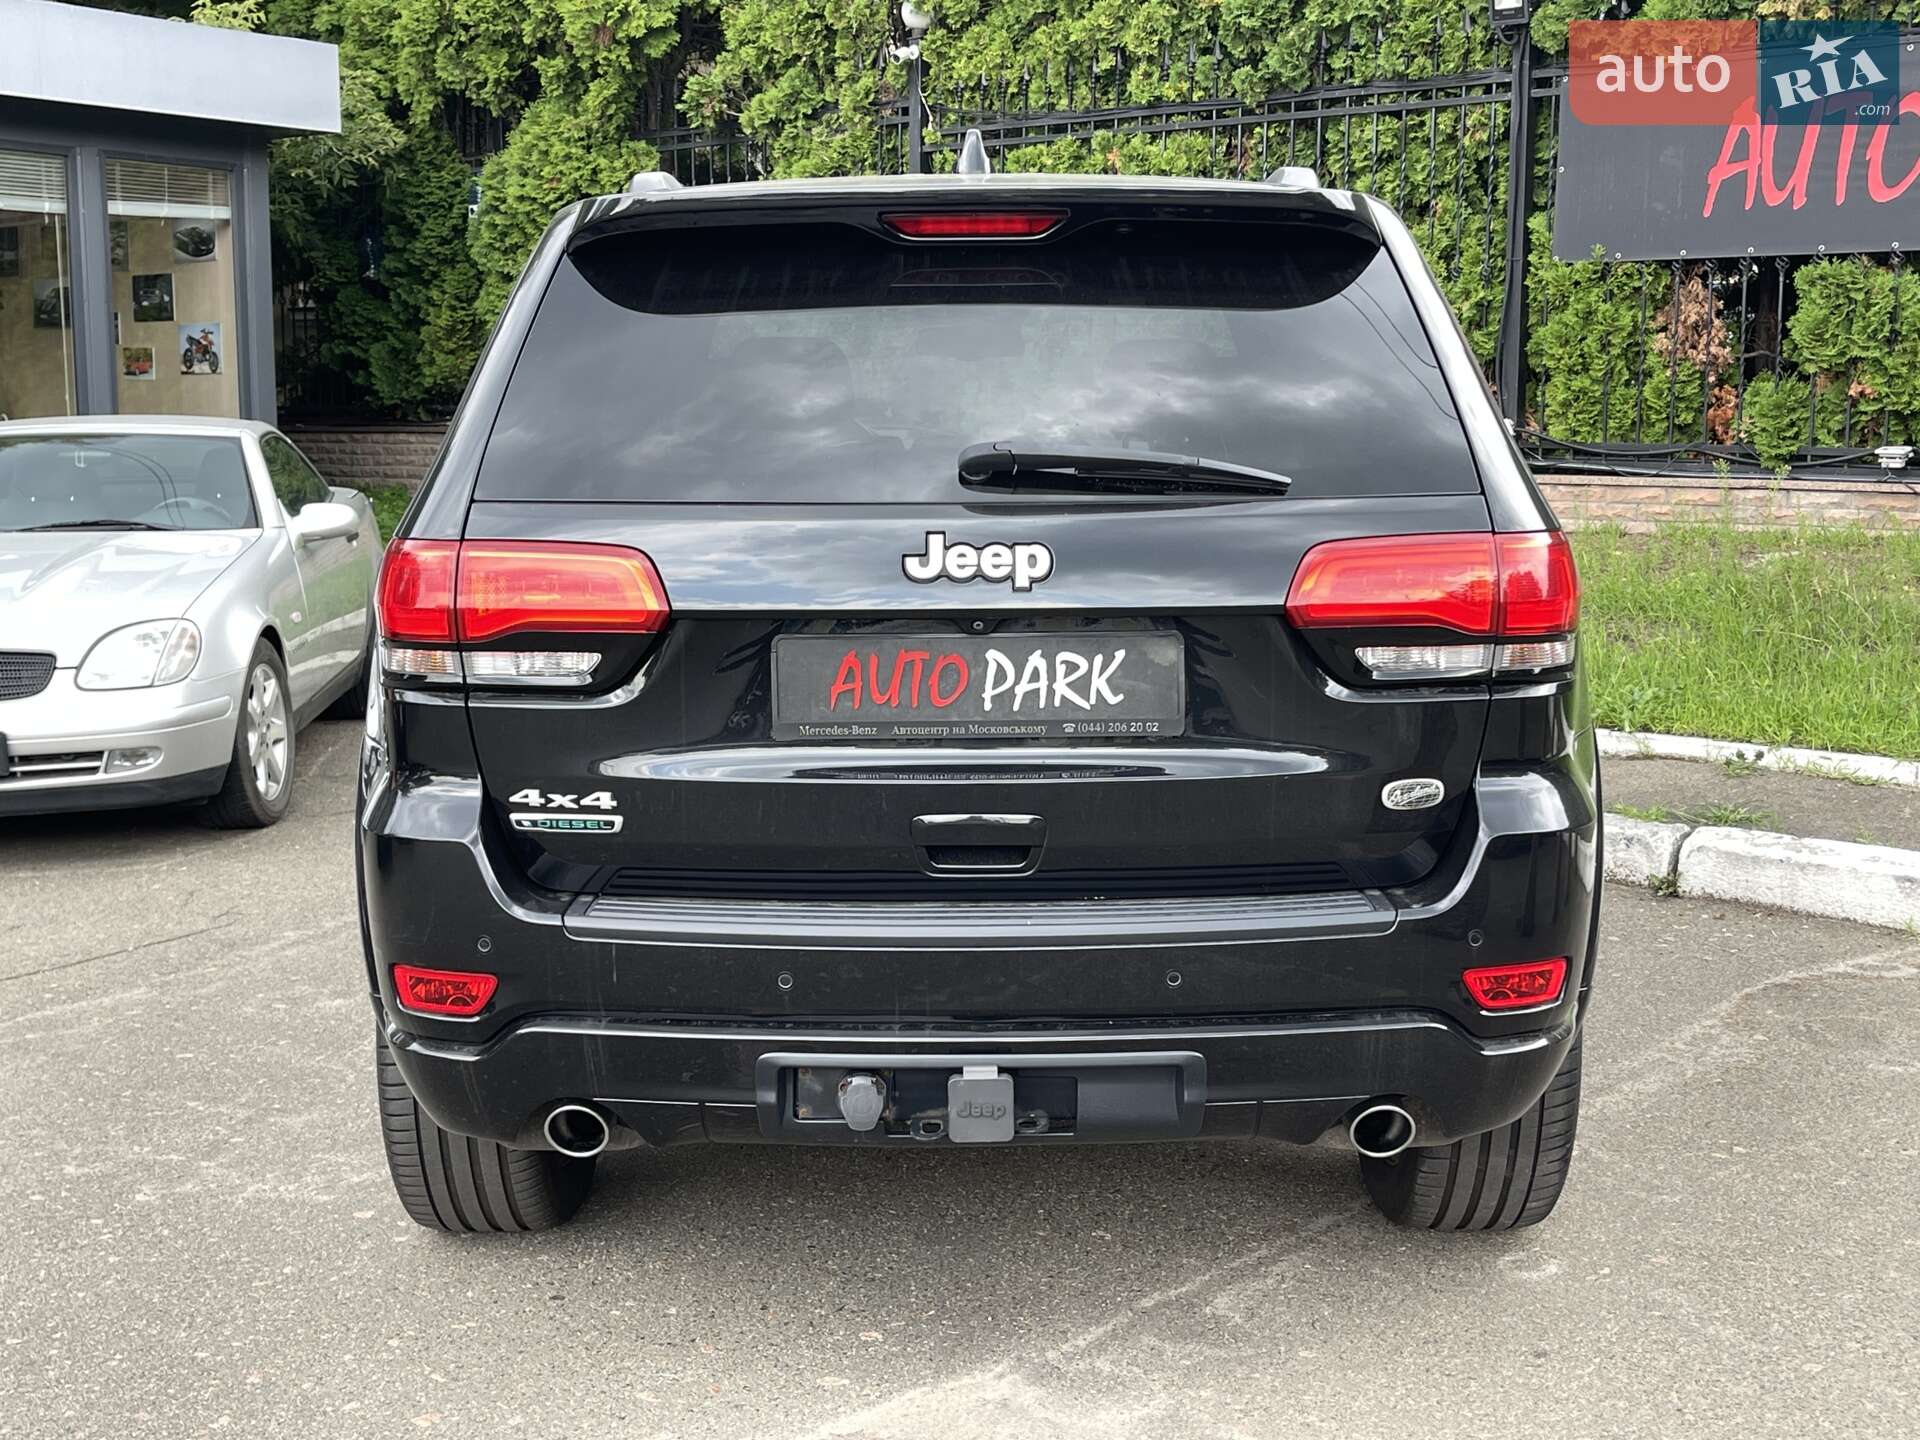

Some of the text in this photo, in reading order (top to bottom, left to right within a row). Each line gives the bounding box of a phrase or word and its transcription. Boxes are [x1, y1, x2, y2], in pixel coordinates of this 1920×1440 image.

[902, 531, 1054, 592] Jeep
[829, 648, 1126, 712] AUTO PARK
[799, 725, 878, 736] Mercedes-Benz
[891, 724, 1048, 737] Автоцентр на Московському
[1077, 722, 1159, 733] (044) 206 20 02
[508, 788, 618, 809] 4x4
[537, 819, 613, 829] DIESEL
[956, 1101, 1007, 1120] Jeep
